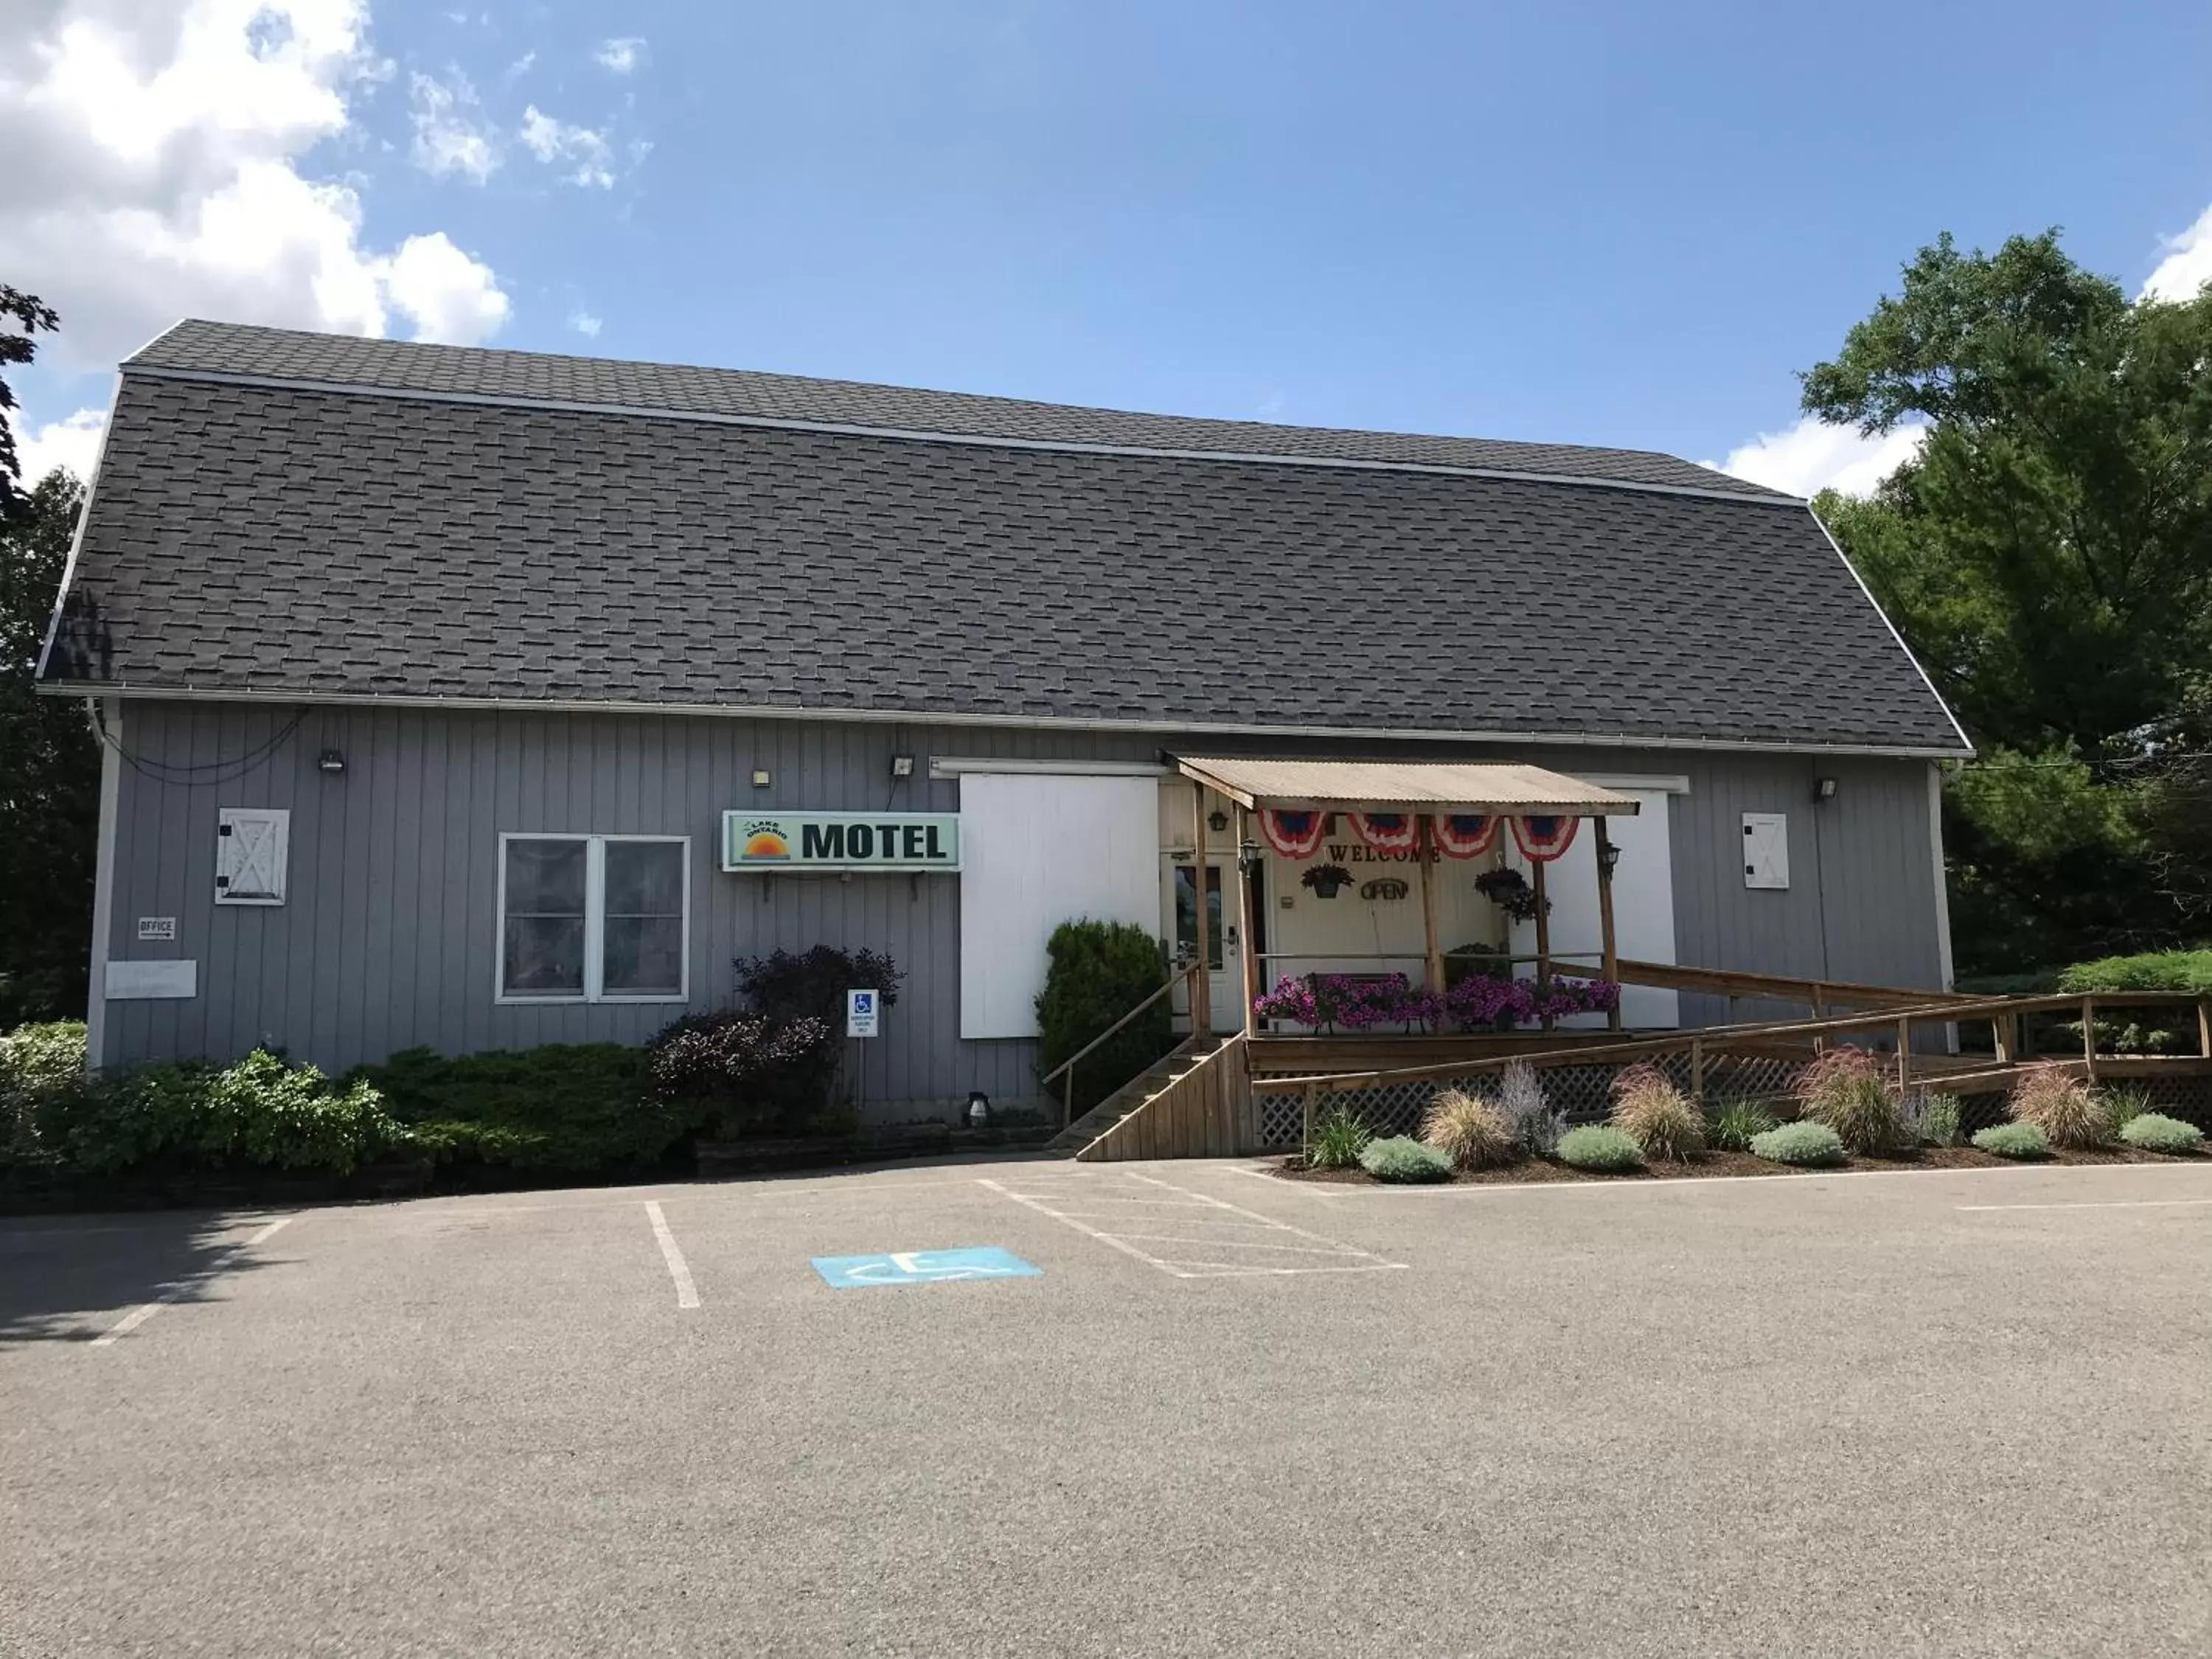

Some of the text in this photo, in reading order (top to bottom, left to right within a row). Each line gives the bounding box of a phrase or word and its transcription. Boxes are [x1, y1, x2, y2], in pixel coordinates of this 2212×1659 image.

[747, 827, 787, 840] ONTARIO
[802, 824, 947, 859] MOTEL
[1361, 883, 1408, 900] OPEN
[141, 921, 174, 931] OFFICE
